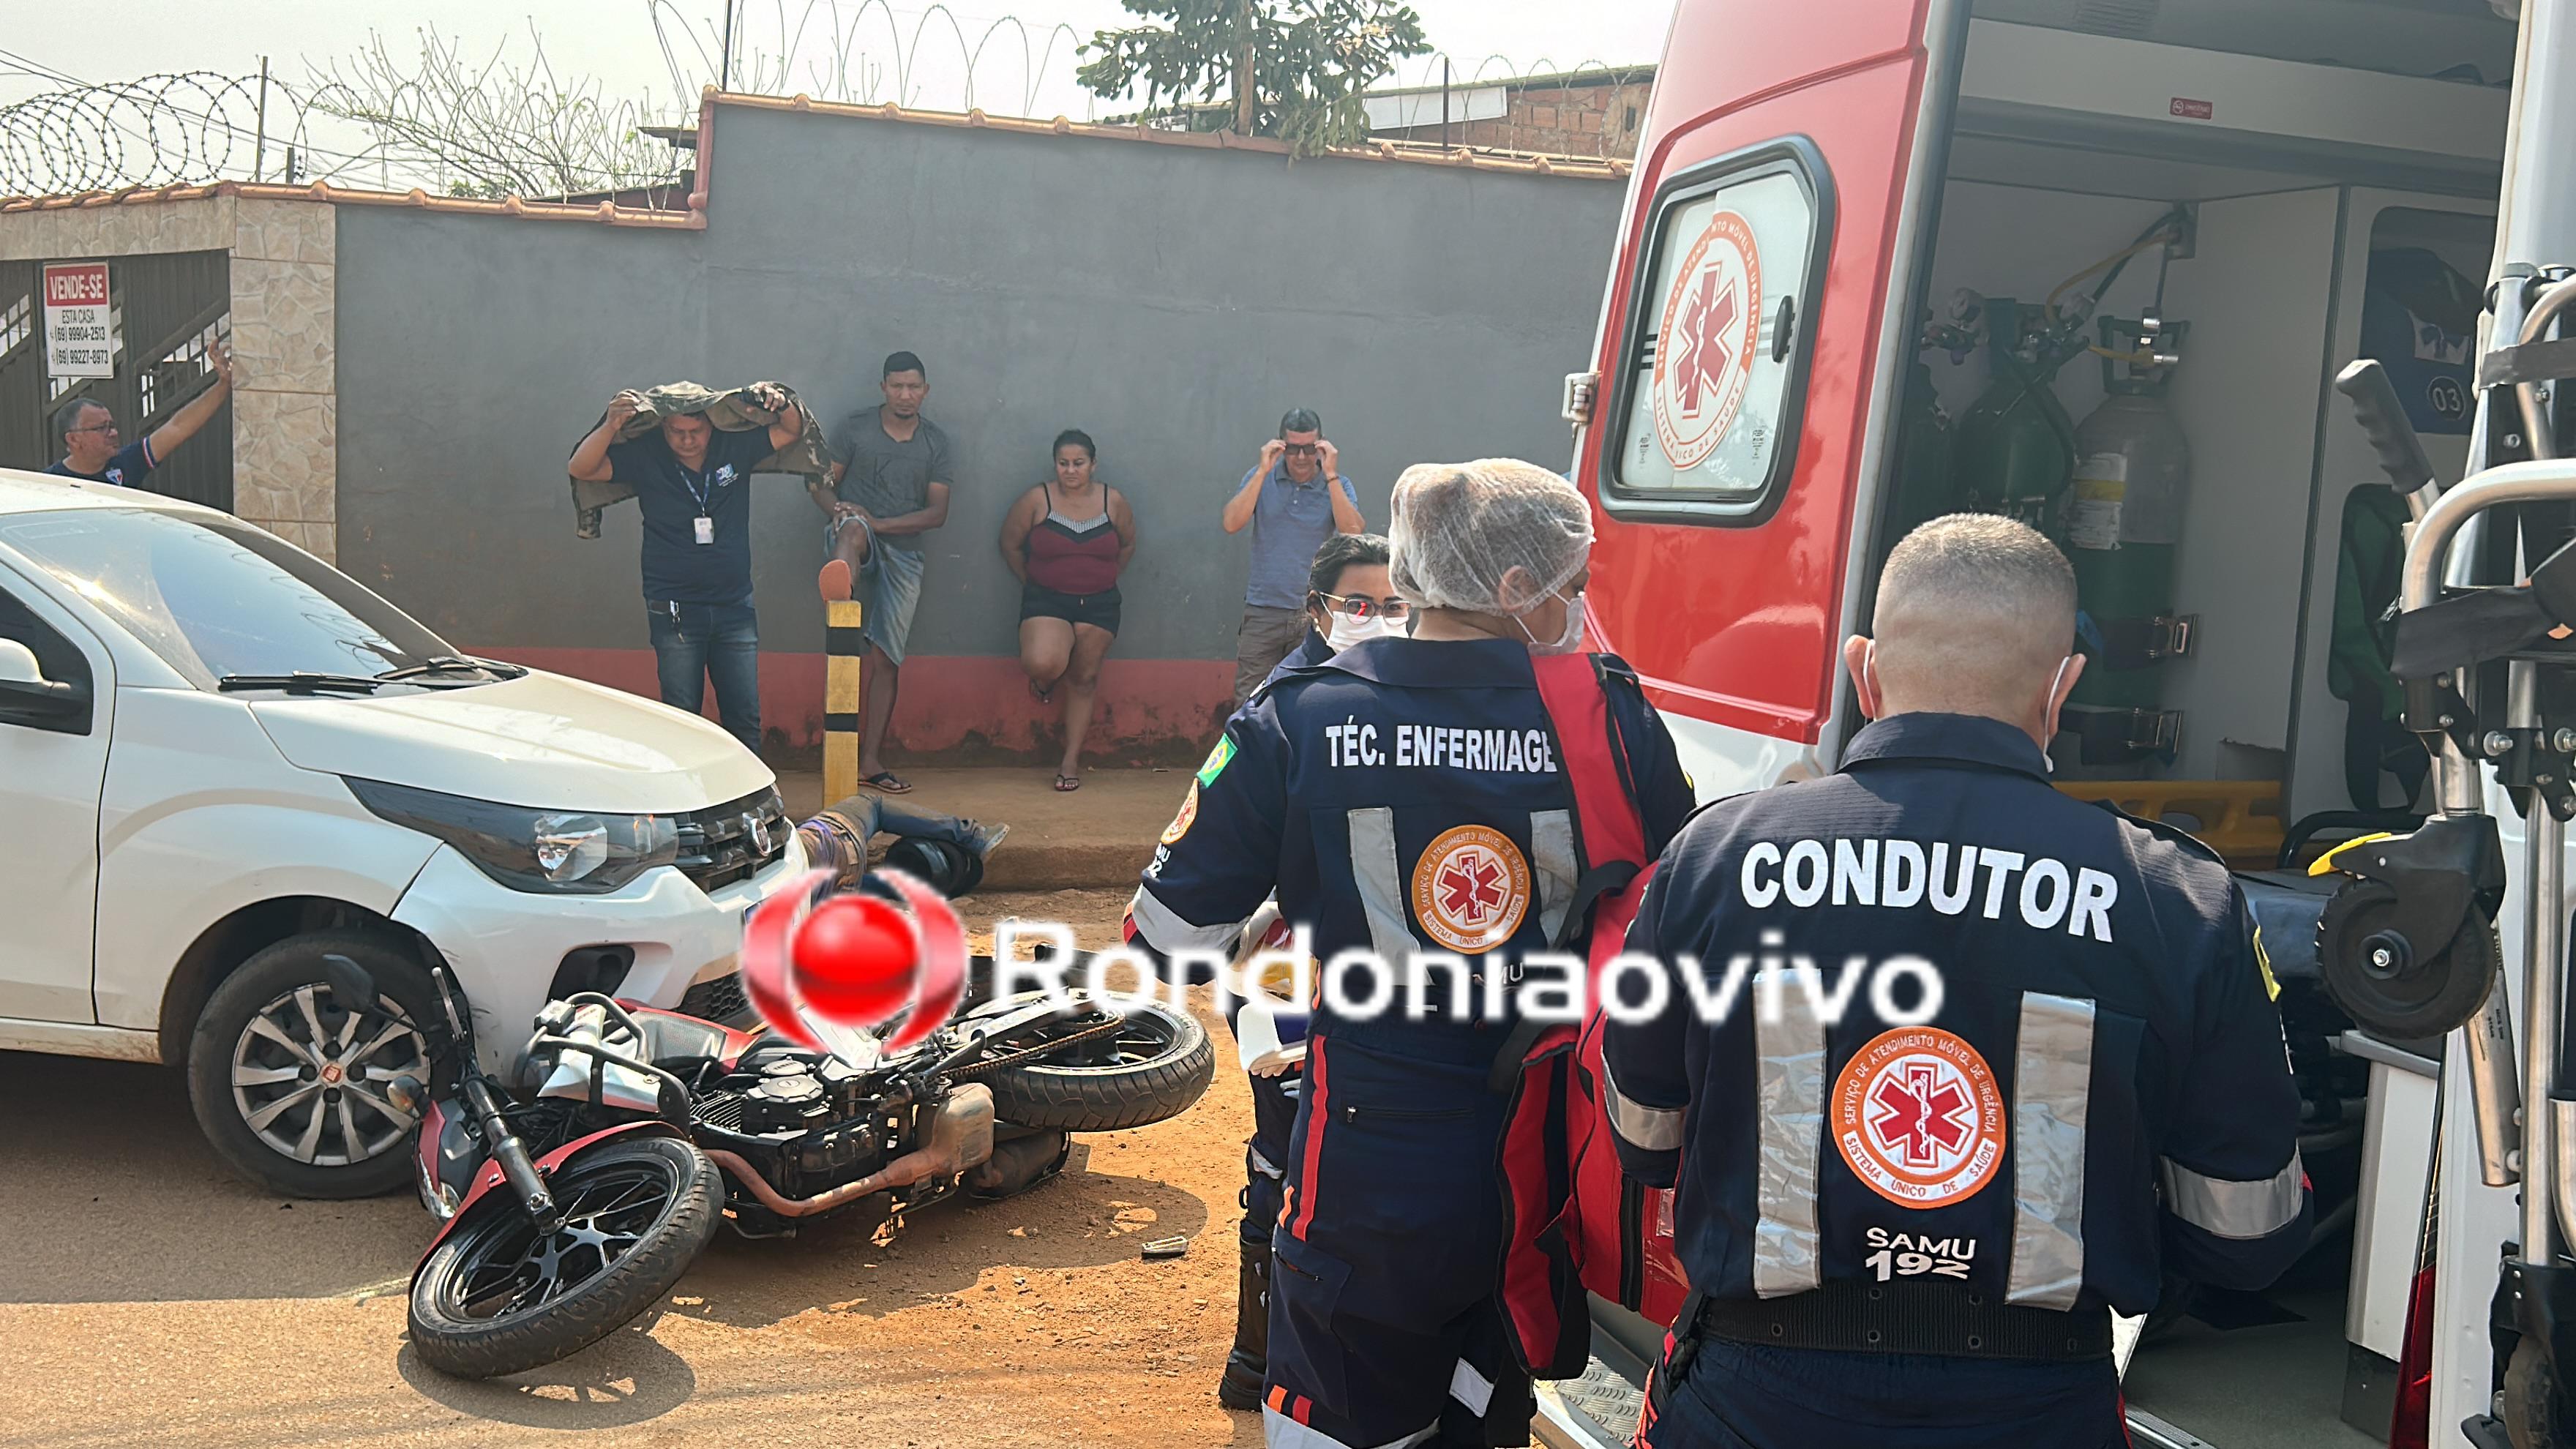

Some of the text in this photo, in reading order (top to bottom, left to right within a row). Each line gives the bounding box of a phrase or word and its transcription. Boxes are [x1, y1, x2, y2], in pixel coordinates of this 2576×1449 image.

[50, 274, 104, 300] VENDE-SE
[62, 309, 95, 324] ESTA CASA
[55, 326, 105, 342] (69) 99904-2513
[56, 348, 108, 366] (69) 99227-8973
[2432, 386, 2460, 411] 03
[1325, 715, 1385, 767] TÉC.
[1430, 831, 1475, 861] ATENDIMENTO
[1741, 839, 2118, 943] CONDUTOR
[1424, 914, 1453, 941] SISTEMA
[1843, 1034, 1999, 1133] SERVIÇO DE ATENDIMENTO MÓVEL DE URGÊNCIA
[1846, 1137, 1883, 1181] SISTEMA
[1943, 1180, 1959, 1195] DE
[1969, 1143, 1995, 1177] SAÚDE
[1866, 1227, 1977, 1260] SAMU
[1865, 1250, 1971, 1282] 192
